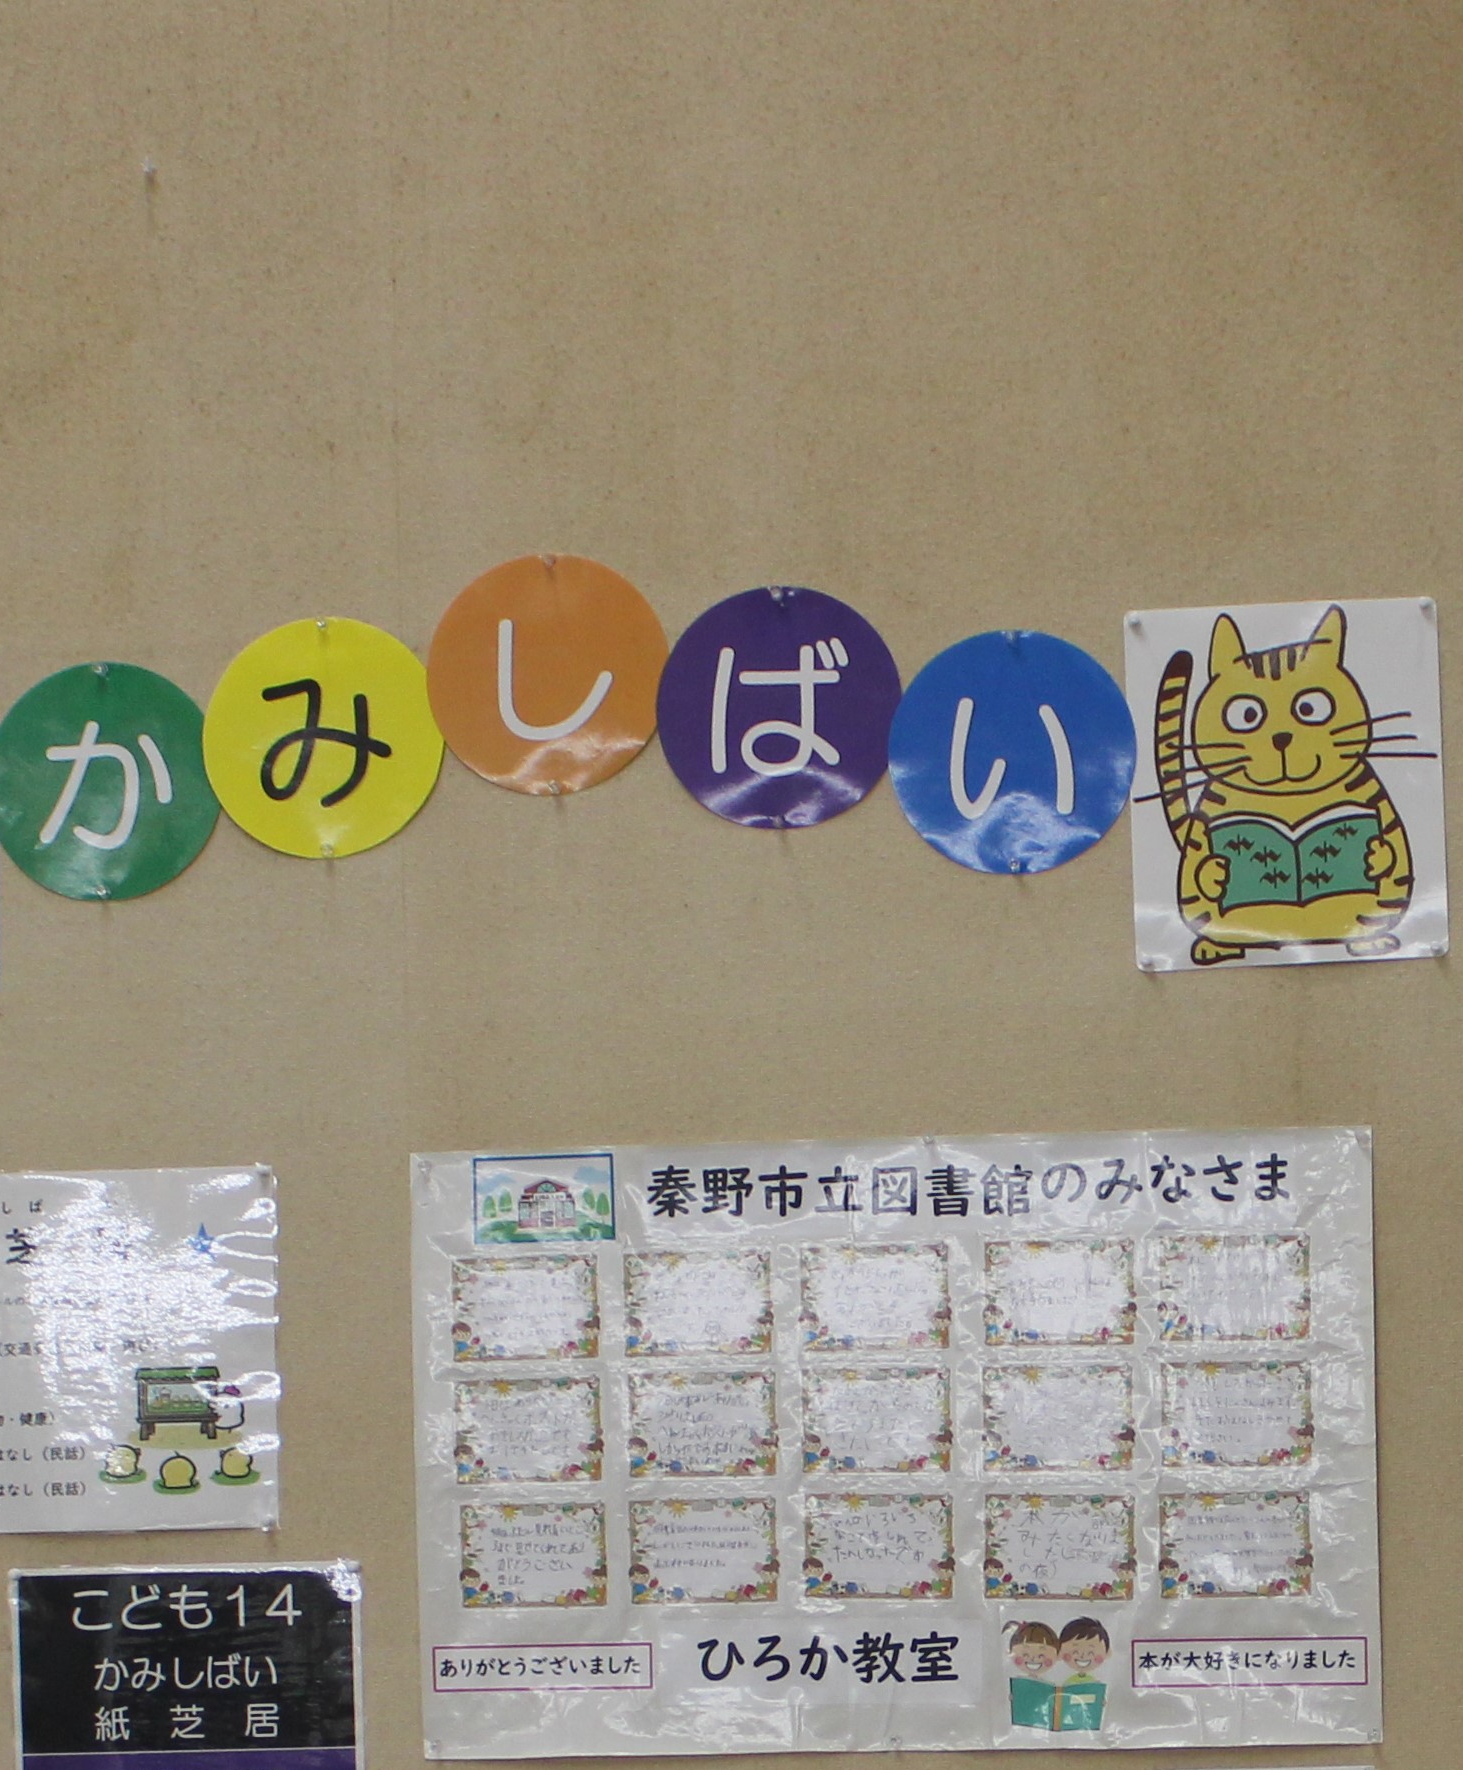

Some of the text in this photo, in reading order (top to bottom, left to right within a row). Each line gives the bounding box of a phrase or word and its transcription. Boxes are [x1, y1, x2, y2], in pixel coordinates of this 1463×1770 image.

[647, 1152, 1290, 1218] 秦野市立図書館のみなさま
[71, 1583, 303, 1631] こども14
[93, 1653, 279, 1691] かみしばい
[438, 1654, 642, 1679] ありがとうございました
[697, 1631, 960, 1683] ひろか教室
[1138, 1650, 1357, 1673] 本が大好きになりました
[94, 1703, 280, 1741] 紙芝居
